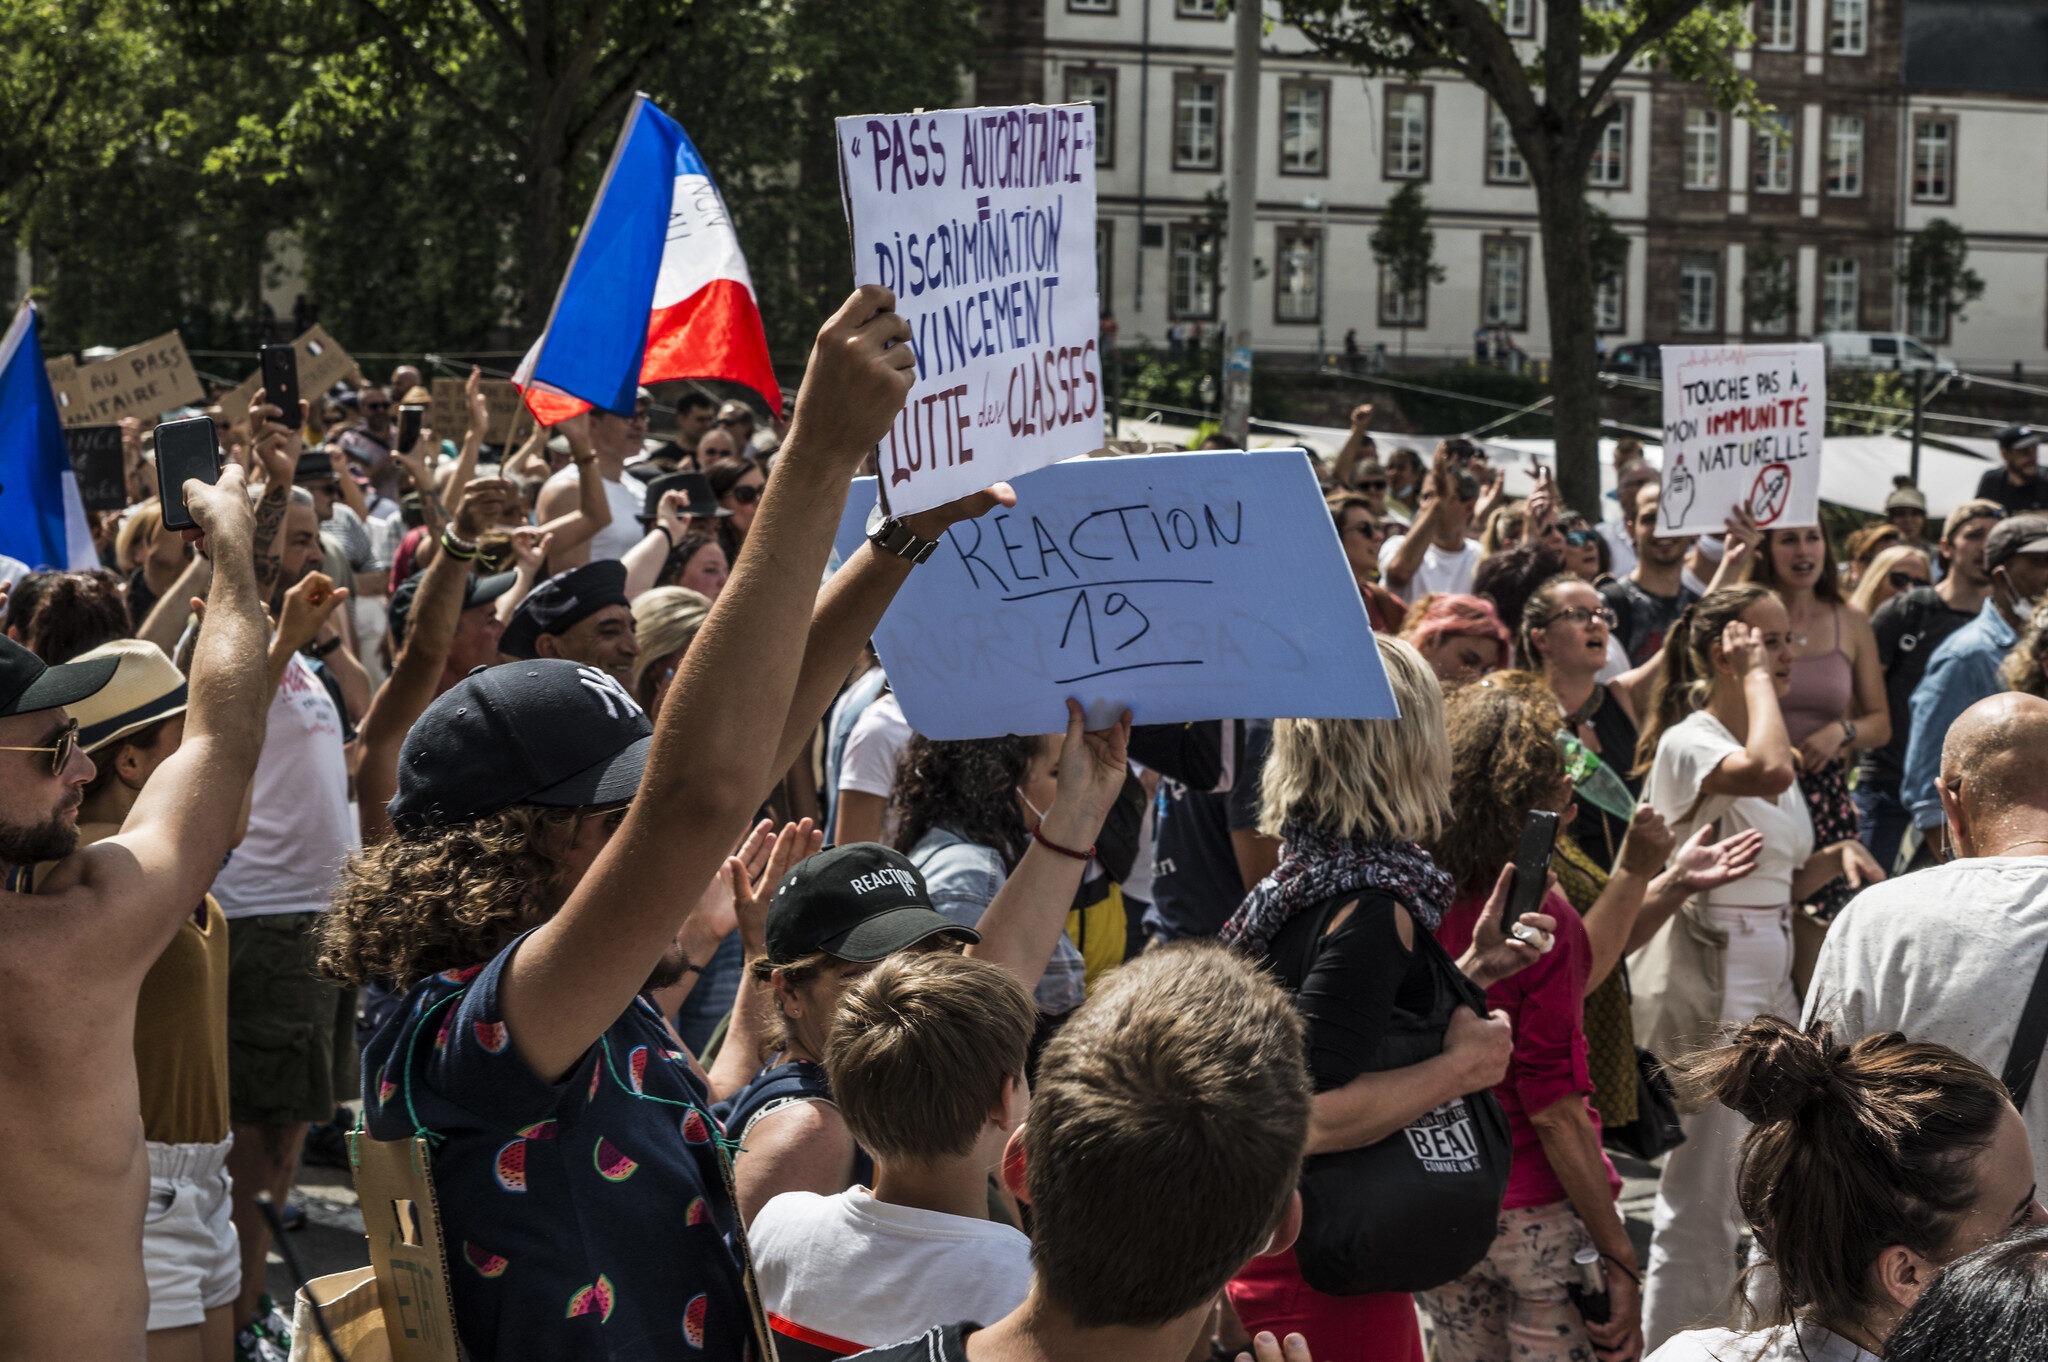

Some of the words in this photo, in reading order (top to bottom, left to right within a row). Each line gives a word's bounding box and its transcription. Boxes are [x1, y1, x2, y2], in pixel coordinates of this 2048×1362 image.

[884, 276, 1060, 382] VINCEMENT
[90, 372, 119, 392] AU
[130, 345, 182, 379] PASS
[1683, 375, 1750, 406] TOUCHE
[1756, 370, 1780, 395] PAS
[890, 383, 974, 488] LUTTE
[1007, 338, 1098, 438] CLASSES
[1665, 418, 1698, 444] MON
[1699, 431, 1810, 474] NATURELLE
[1059, 589, 1150, 665] 19
